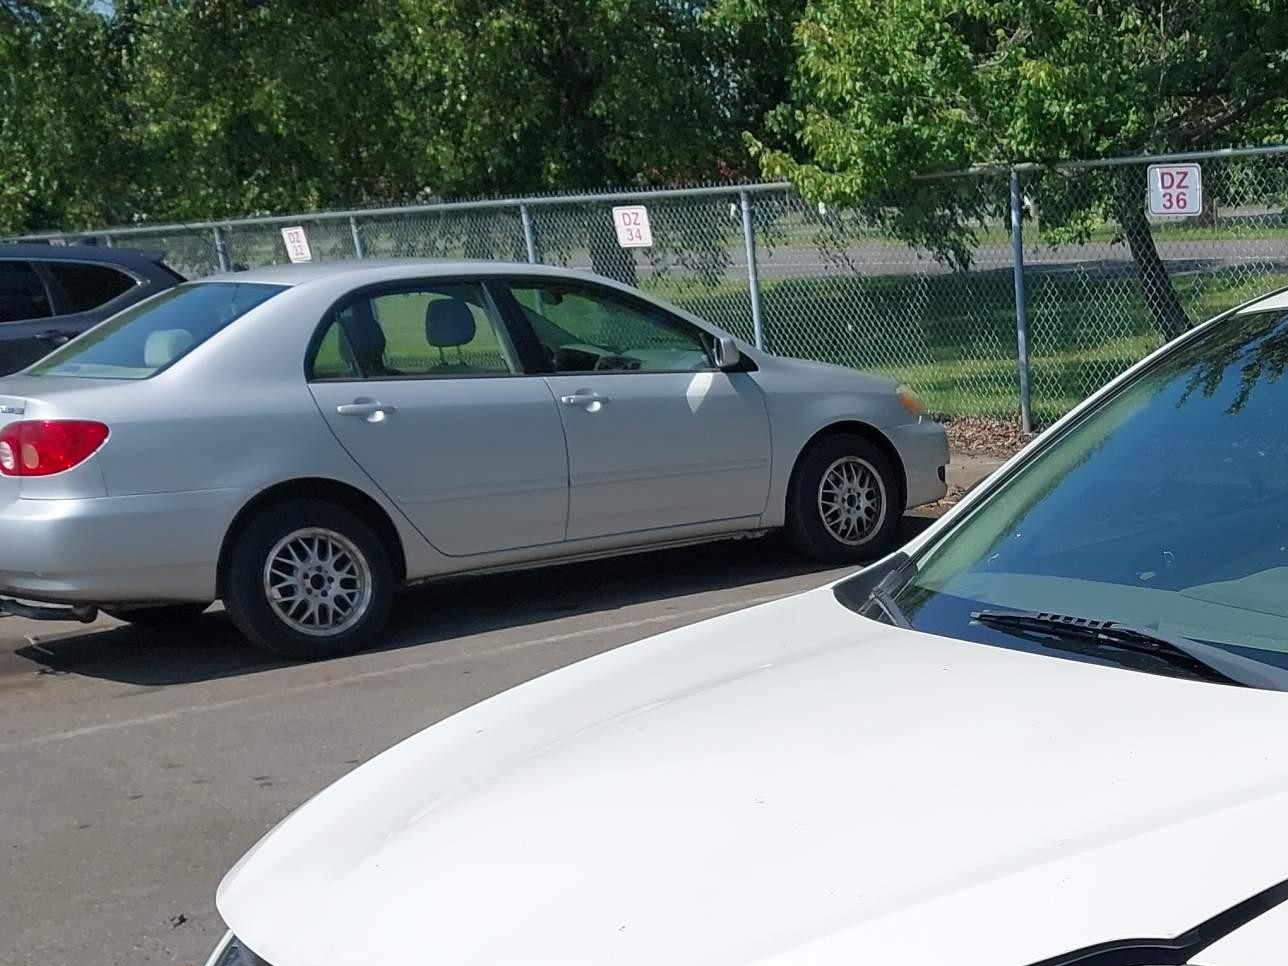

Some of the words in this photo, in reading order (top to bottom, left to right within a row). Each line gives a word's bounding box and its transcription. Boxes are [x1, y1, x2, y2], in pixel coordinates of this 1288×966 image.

[1160, 171, 1189, 190] DZ
[1162, 191, 1187, 210] 36
[622, 212, 641, 226] DZ
[287, 231, 301, 244] DZ
[626, 228, 642, 241] 34
